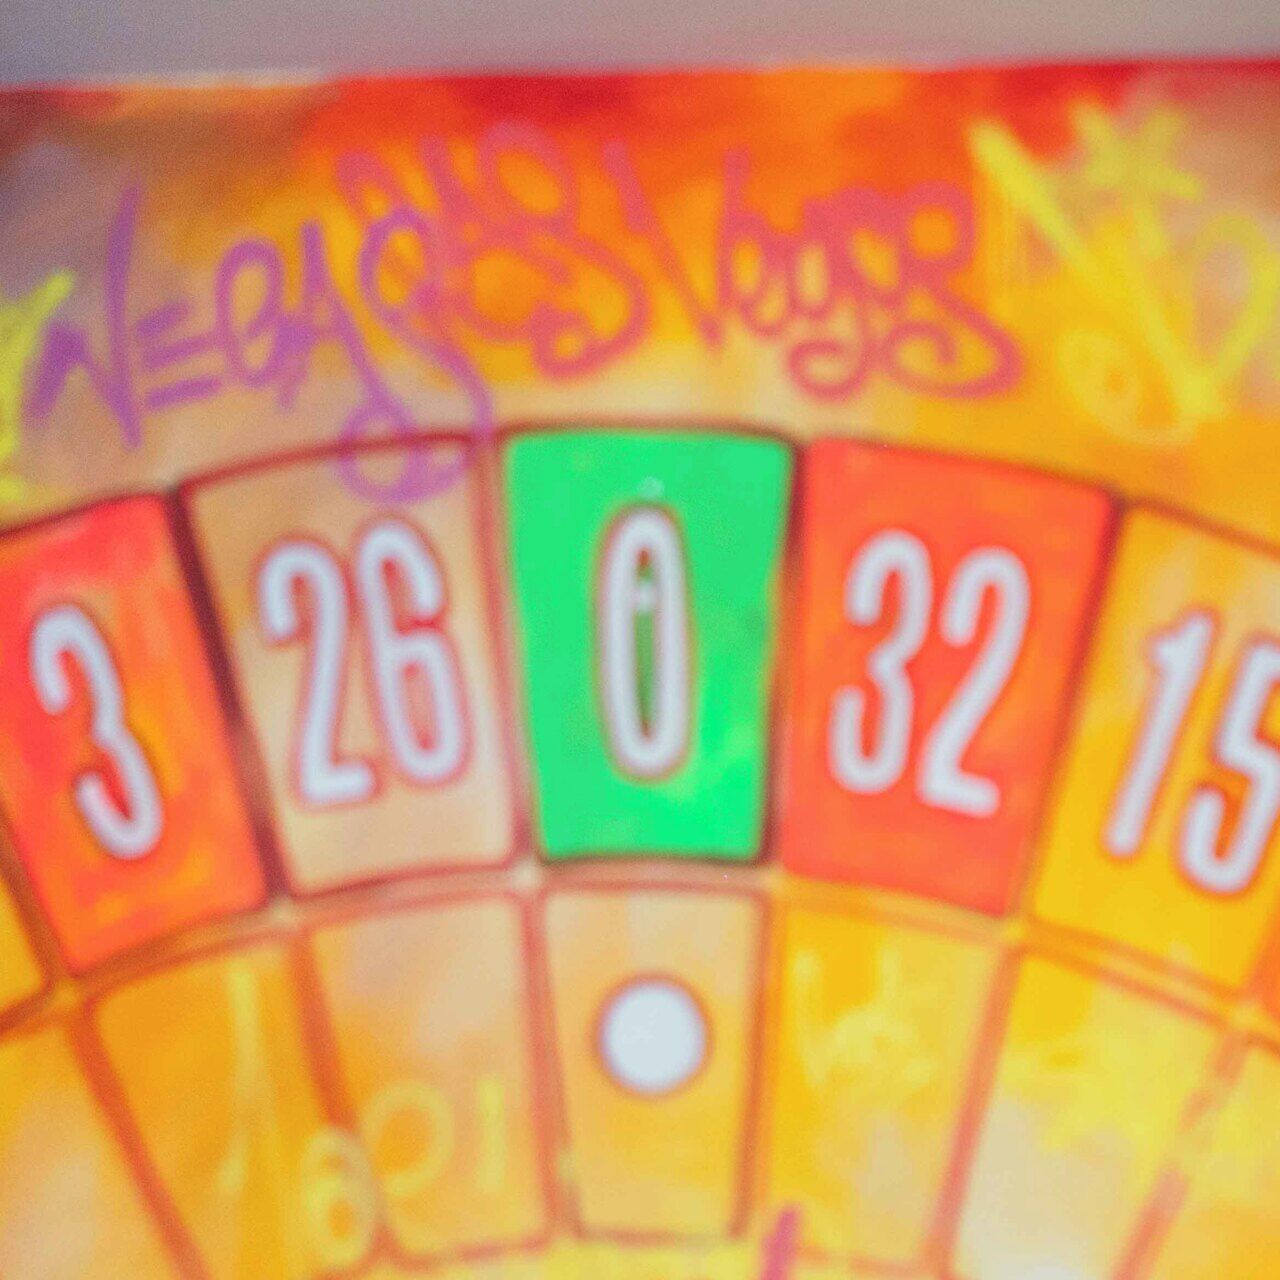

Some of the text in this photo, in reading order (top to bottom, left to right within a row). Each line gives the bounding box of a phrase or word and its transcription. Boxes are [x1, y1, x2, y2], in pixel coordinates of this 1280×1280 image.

[29, 604, 163, 860] 3
[258, 520, 470, 802] 26
[600, 508, 688, 780] 0
[829, 528, 1030, 818] 32
